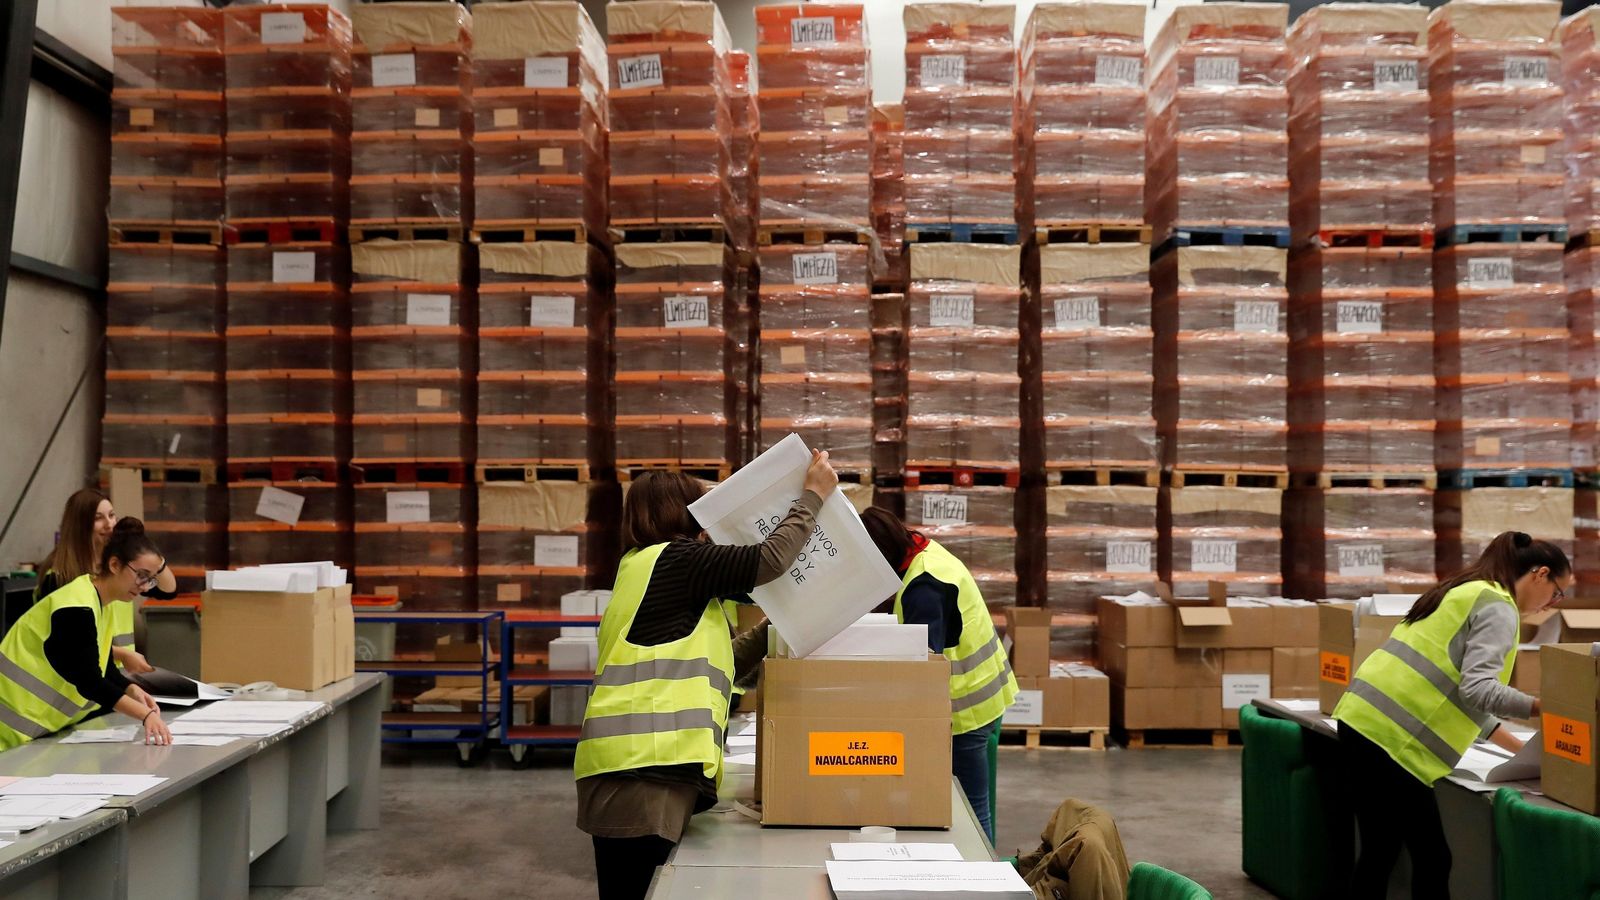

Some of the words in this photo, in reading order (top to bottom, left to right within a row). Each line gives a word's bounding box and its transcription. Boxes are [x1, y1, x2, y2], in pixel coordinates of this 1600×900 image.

[792, 19, 833, 43] LIMPIEZA
[619, 59, 660, 84] LIMPIEZA
[793, 255, 835, 279] LIMPIEZA
[665, 298, 707, 322] LIMPIEZA
[923, 496, 965, 520] LIMPIEZA
[790, 567, 806, 585] DE
[847, 741, 869, 750] J.E.Z.
[1555, 738, 1582, 757] ARANJUEZ
[815, 755, 898, 766] NAVALCARNERO
